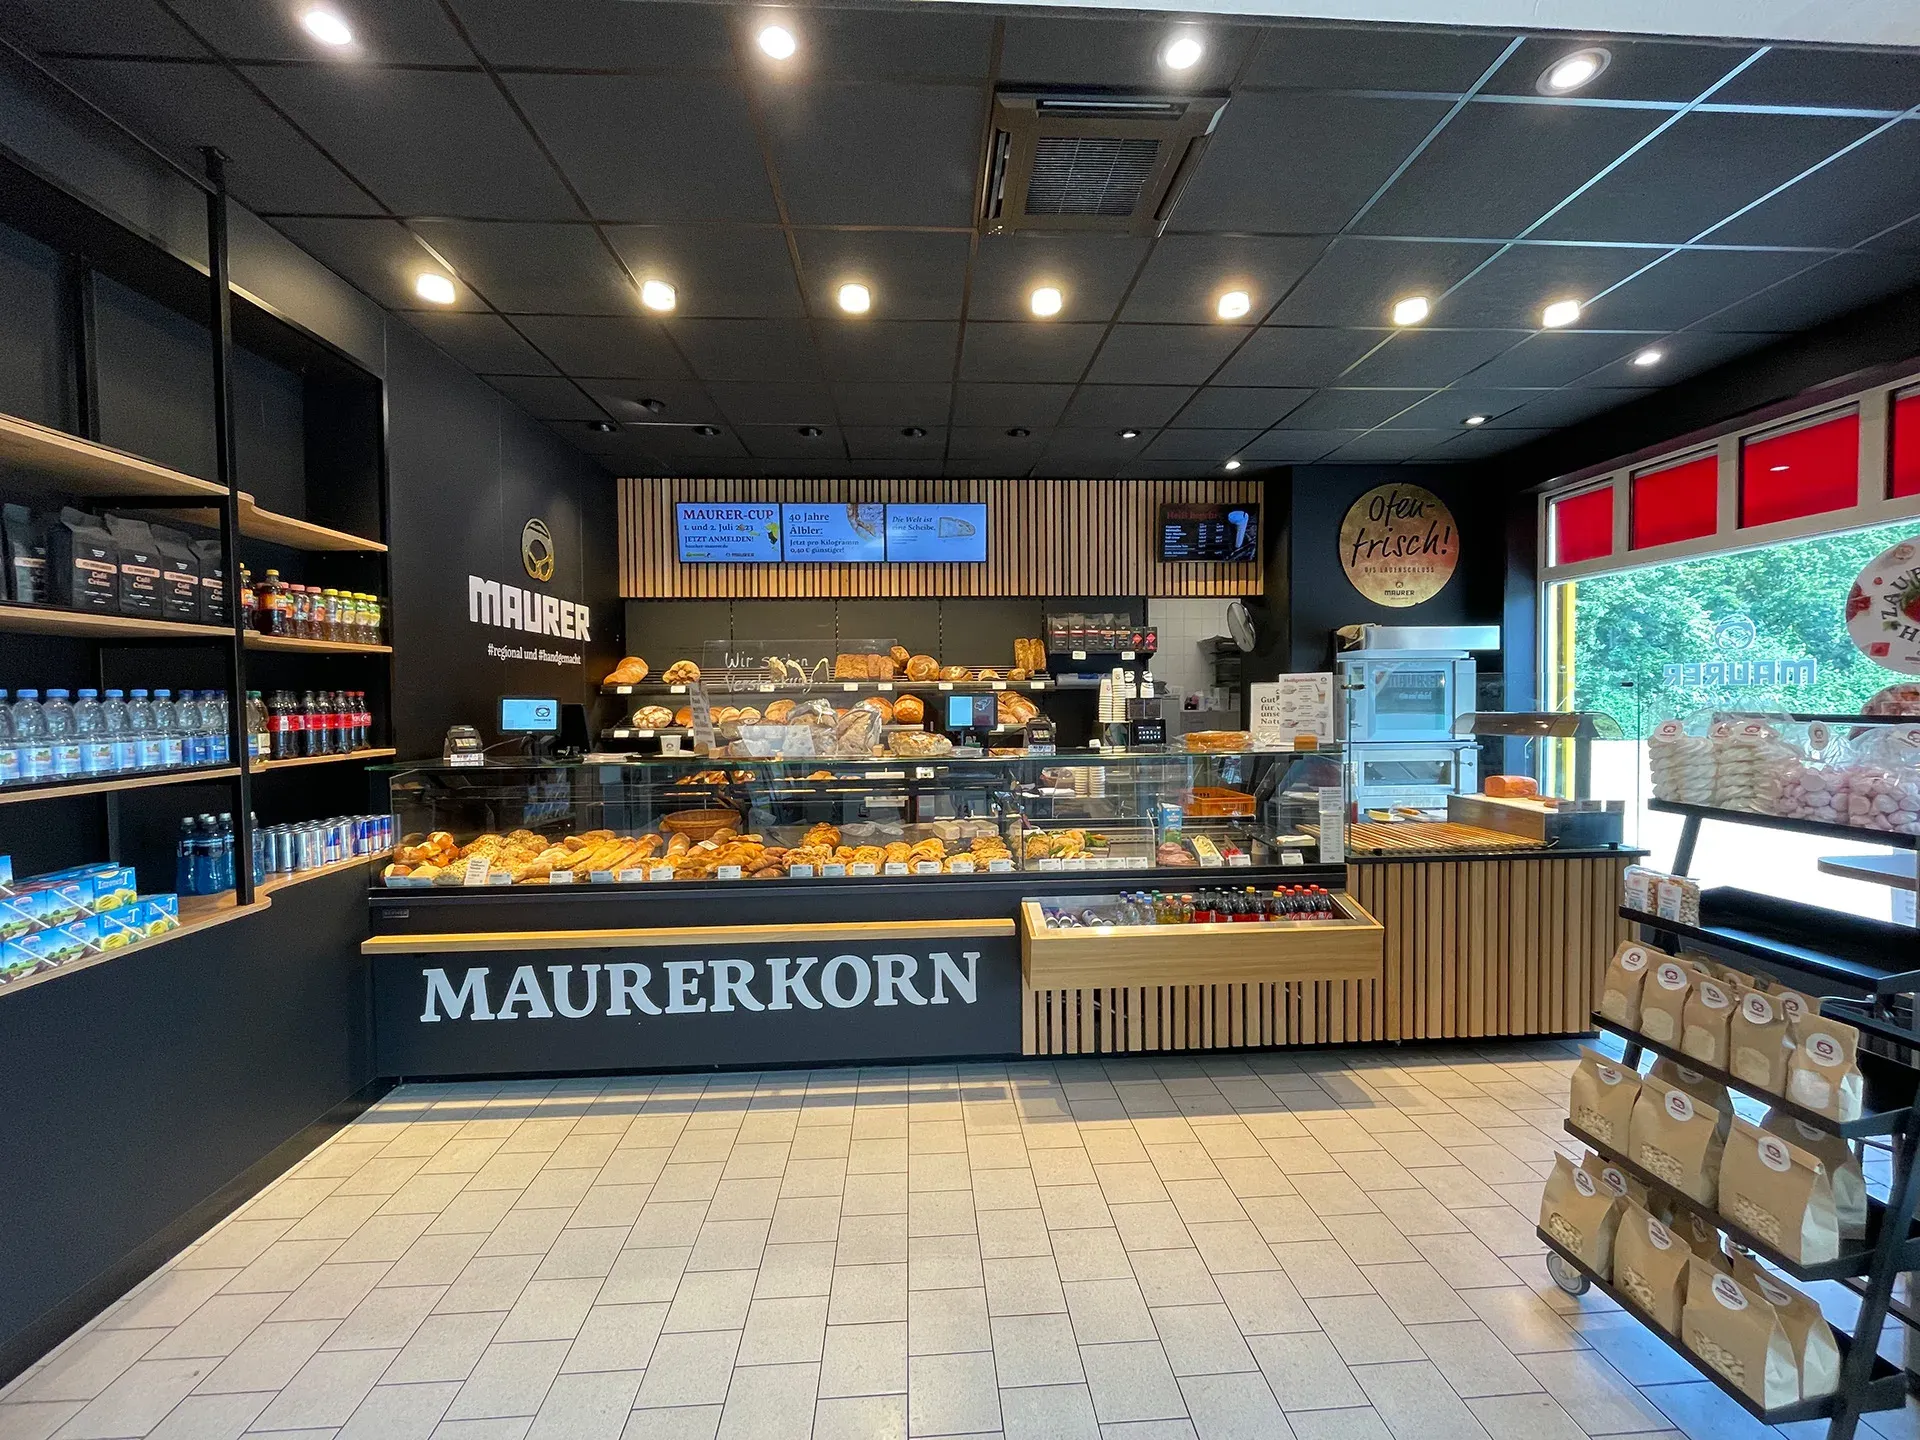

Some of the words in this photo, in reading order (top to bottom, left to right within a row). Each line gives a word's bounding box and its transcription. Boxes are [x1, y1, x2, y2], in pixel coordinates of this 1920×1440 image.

[683, 509, 774, 520] MAURER-CUP
[789, 513, 801, 522] 40
[804, 512, 829, 522] Jahre
[1368, 490, 1435, 527] Ofen-
[719, 523, 733, 532] Juli
[685, 536, 707, 544] JETZT
[790, 539, 805, 547] Jetzt
[820, 539, 859, 547] Kilogramm
[1351, 520, 1451, 568] frisch!
[468, 574, 591, 642] MAURER
[1899, 625, 1920, 644] H
[488, 642, 523, 661] #regional
[523, 648, 538, 660] und
[538, 649, 581, 666] #handgemacht
[724, 651, 753, 669] Wir
[418, 951, 981, 1023] MAURERKORN
